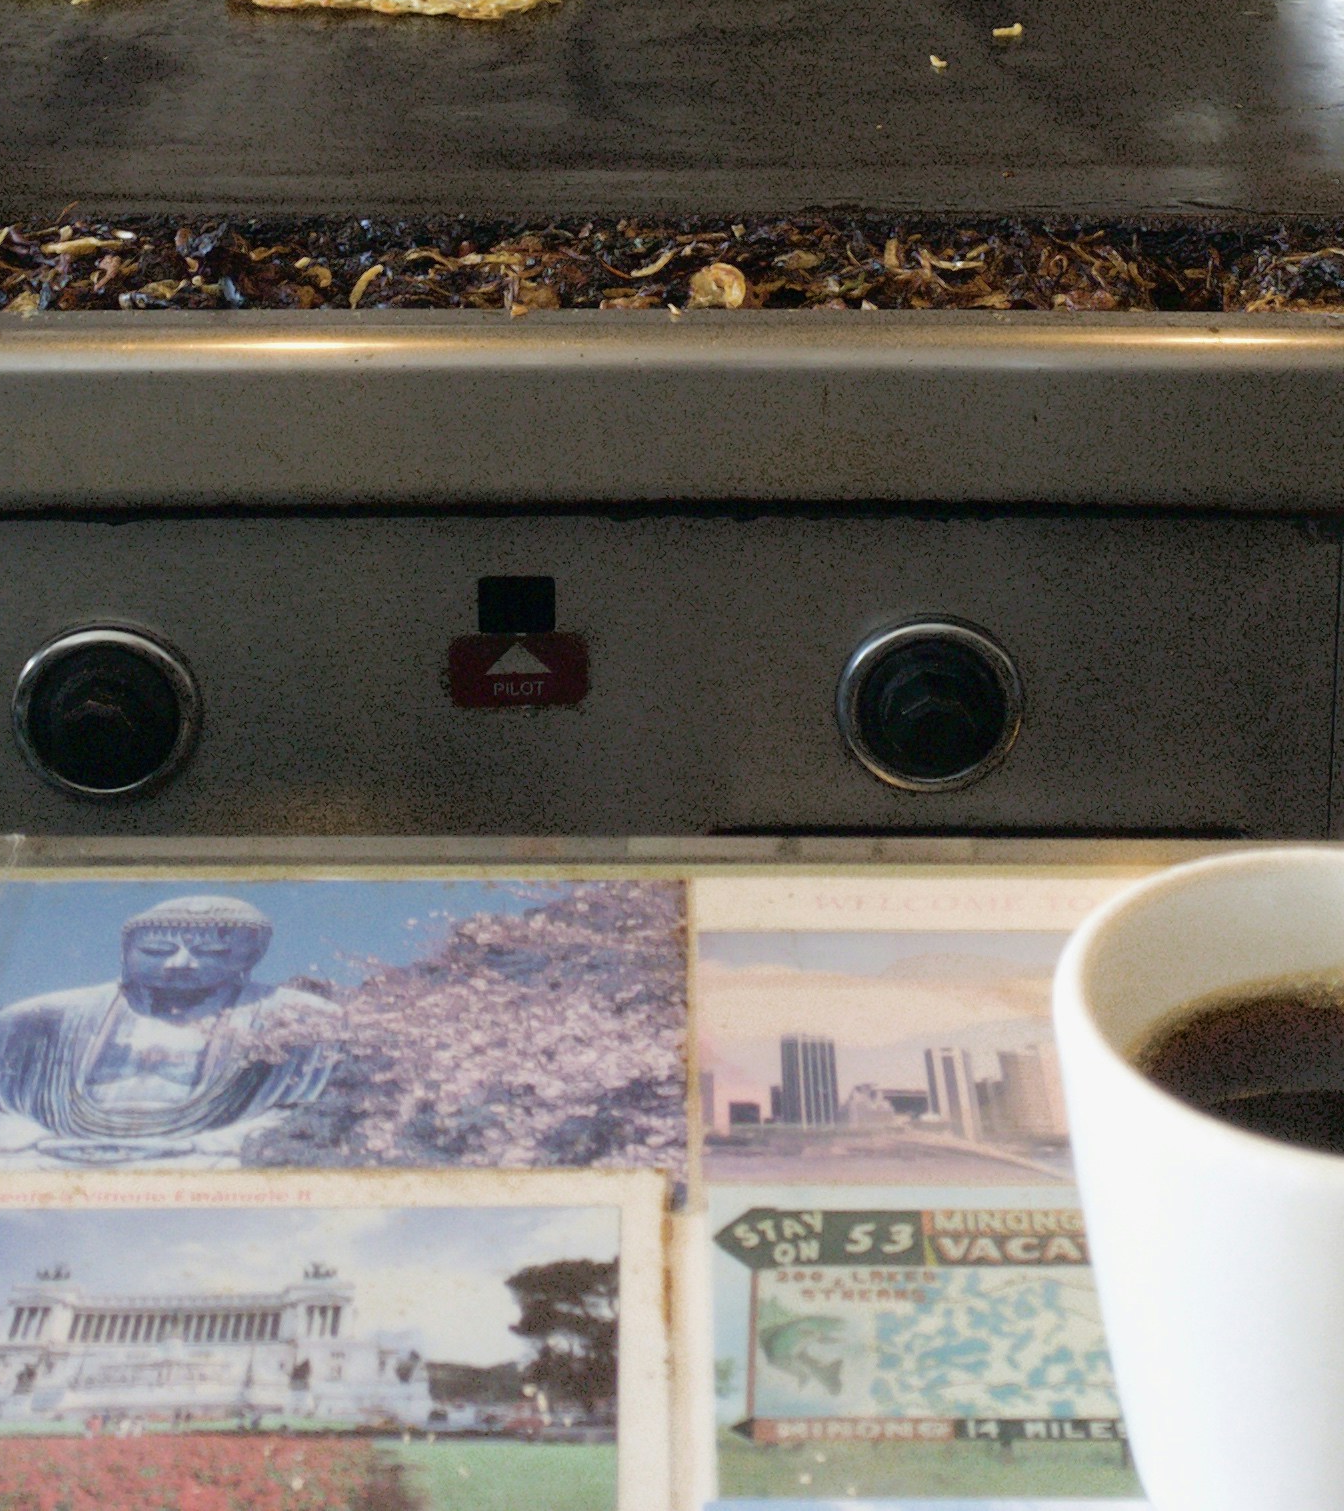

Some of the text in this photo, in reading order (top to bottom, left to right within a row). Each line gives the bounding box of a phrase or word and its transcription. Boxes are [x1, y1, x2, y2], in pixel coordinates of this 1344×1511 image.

[493, 680, 545, 696] PILOT
[813, 893, 1096, 913] WELCOME TO
[732, 1210, 825, 1249] STAY
[843, 1222, 915, 1255] 53
[772, 1238, 821, 1265] ON
[935, 1235, 1092, 1263] VACA
[852, 1270, 936, 1284] LAKES
[801, 1288, 927, 1303] STREAMS
